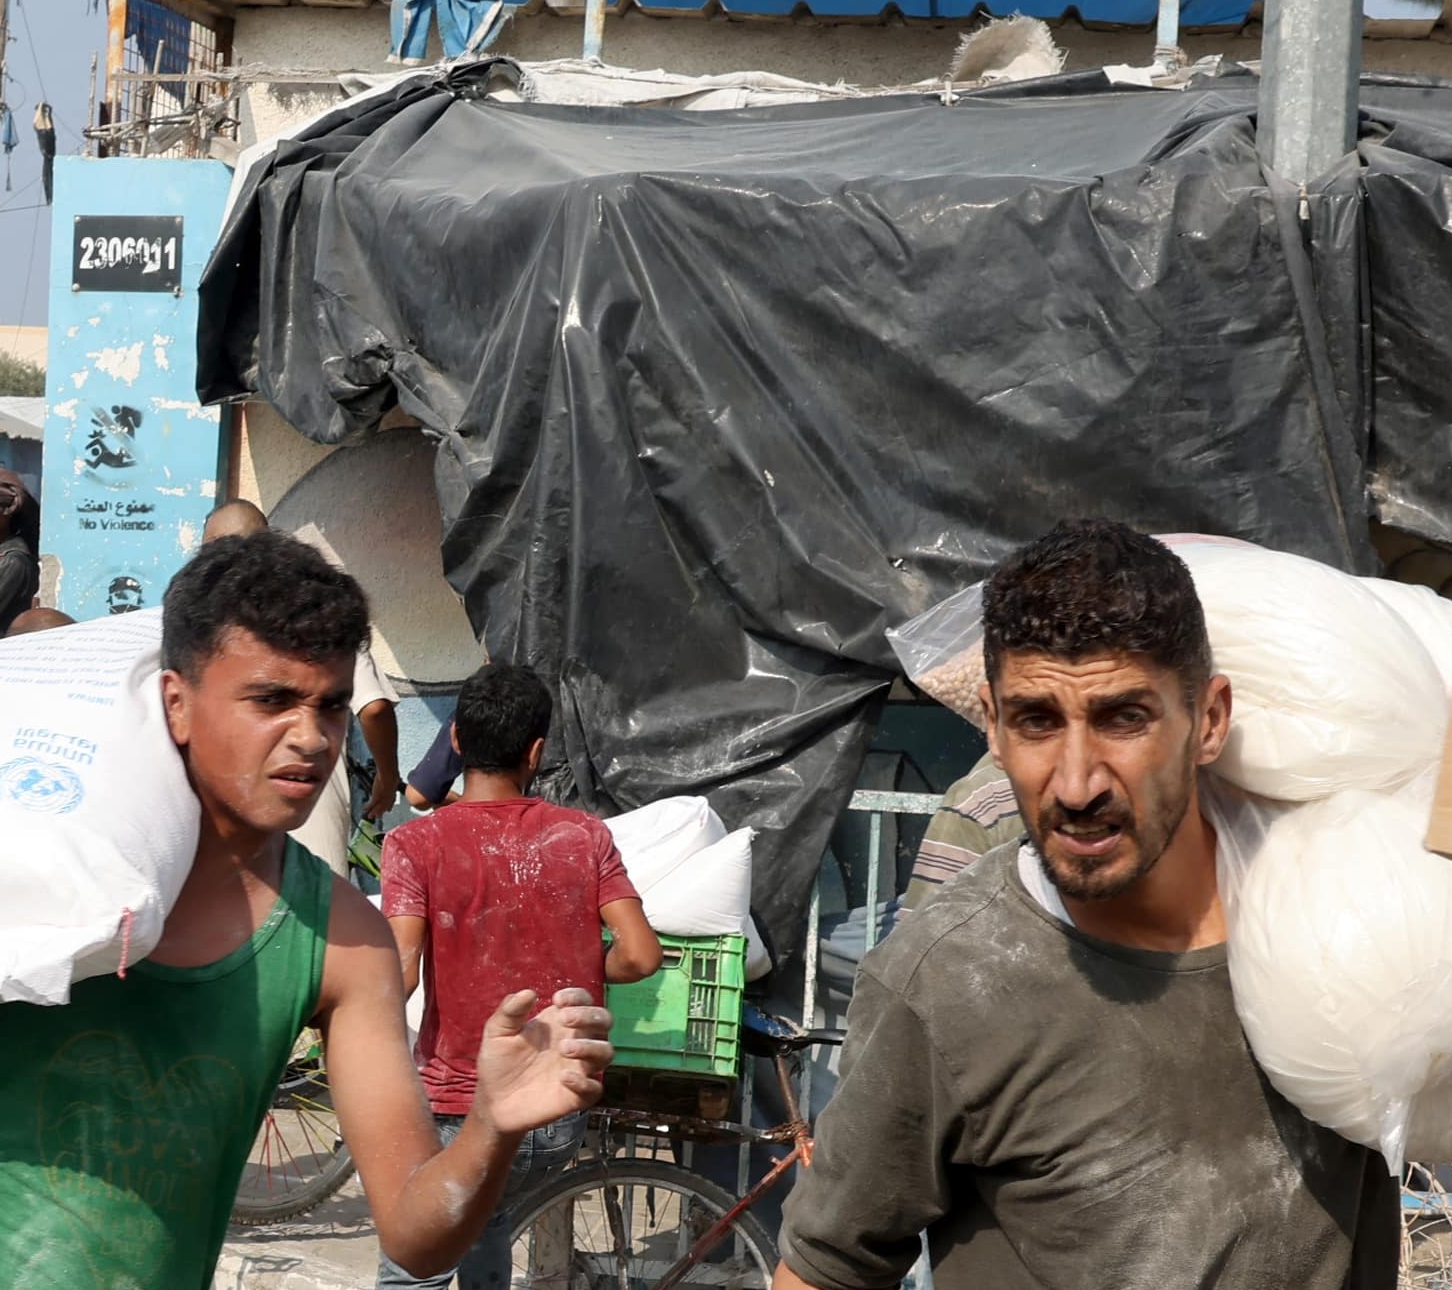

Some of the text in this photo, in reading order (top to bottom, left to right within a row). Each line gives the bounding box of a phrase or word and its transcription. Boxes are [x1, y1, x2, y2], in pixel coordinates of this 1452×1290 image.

[79, 518, 155, 531] No Violence
[13, 737, 94, 766] unrwa
